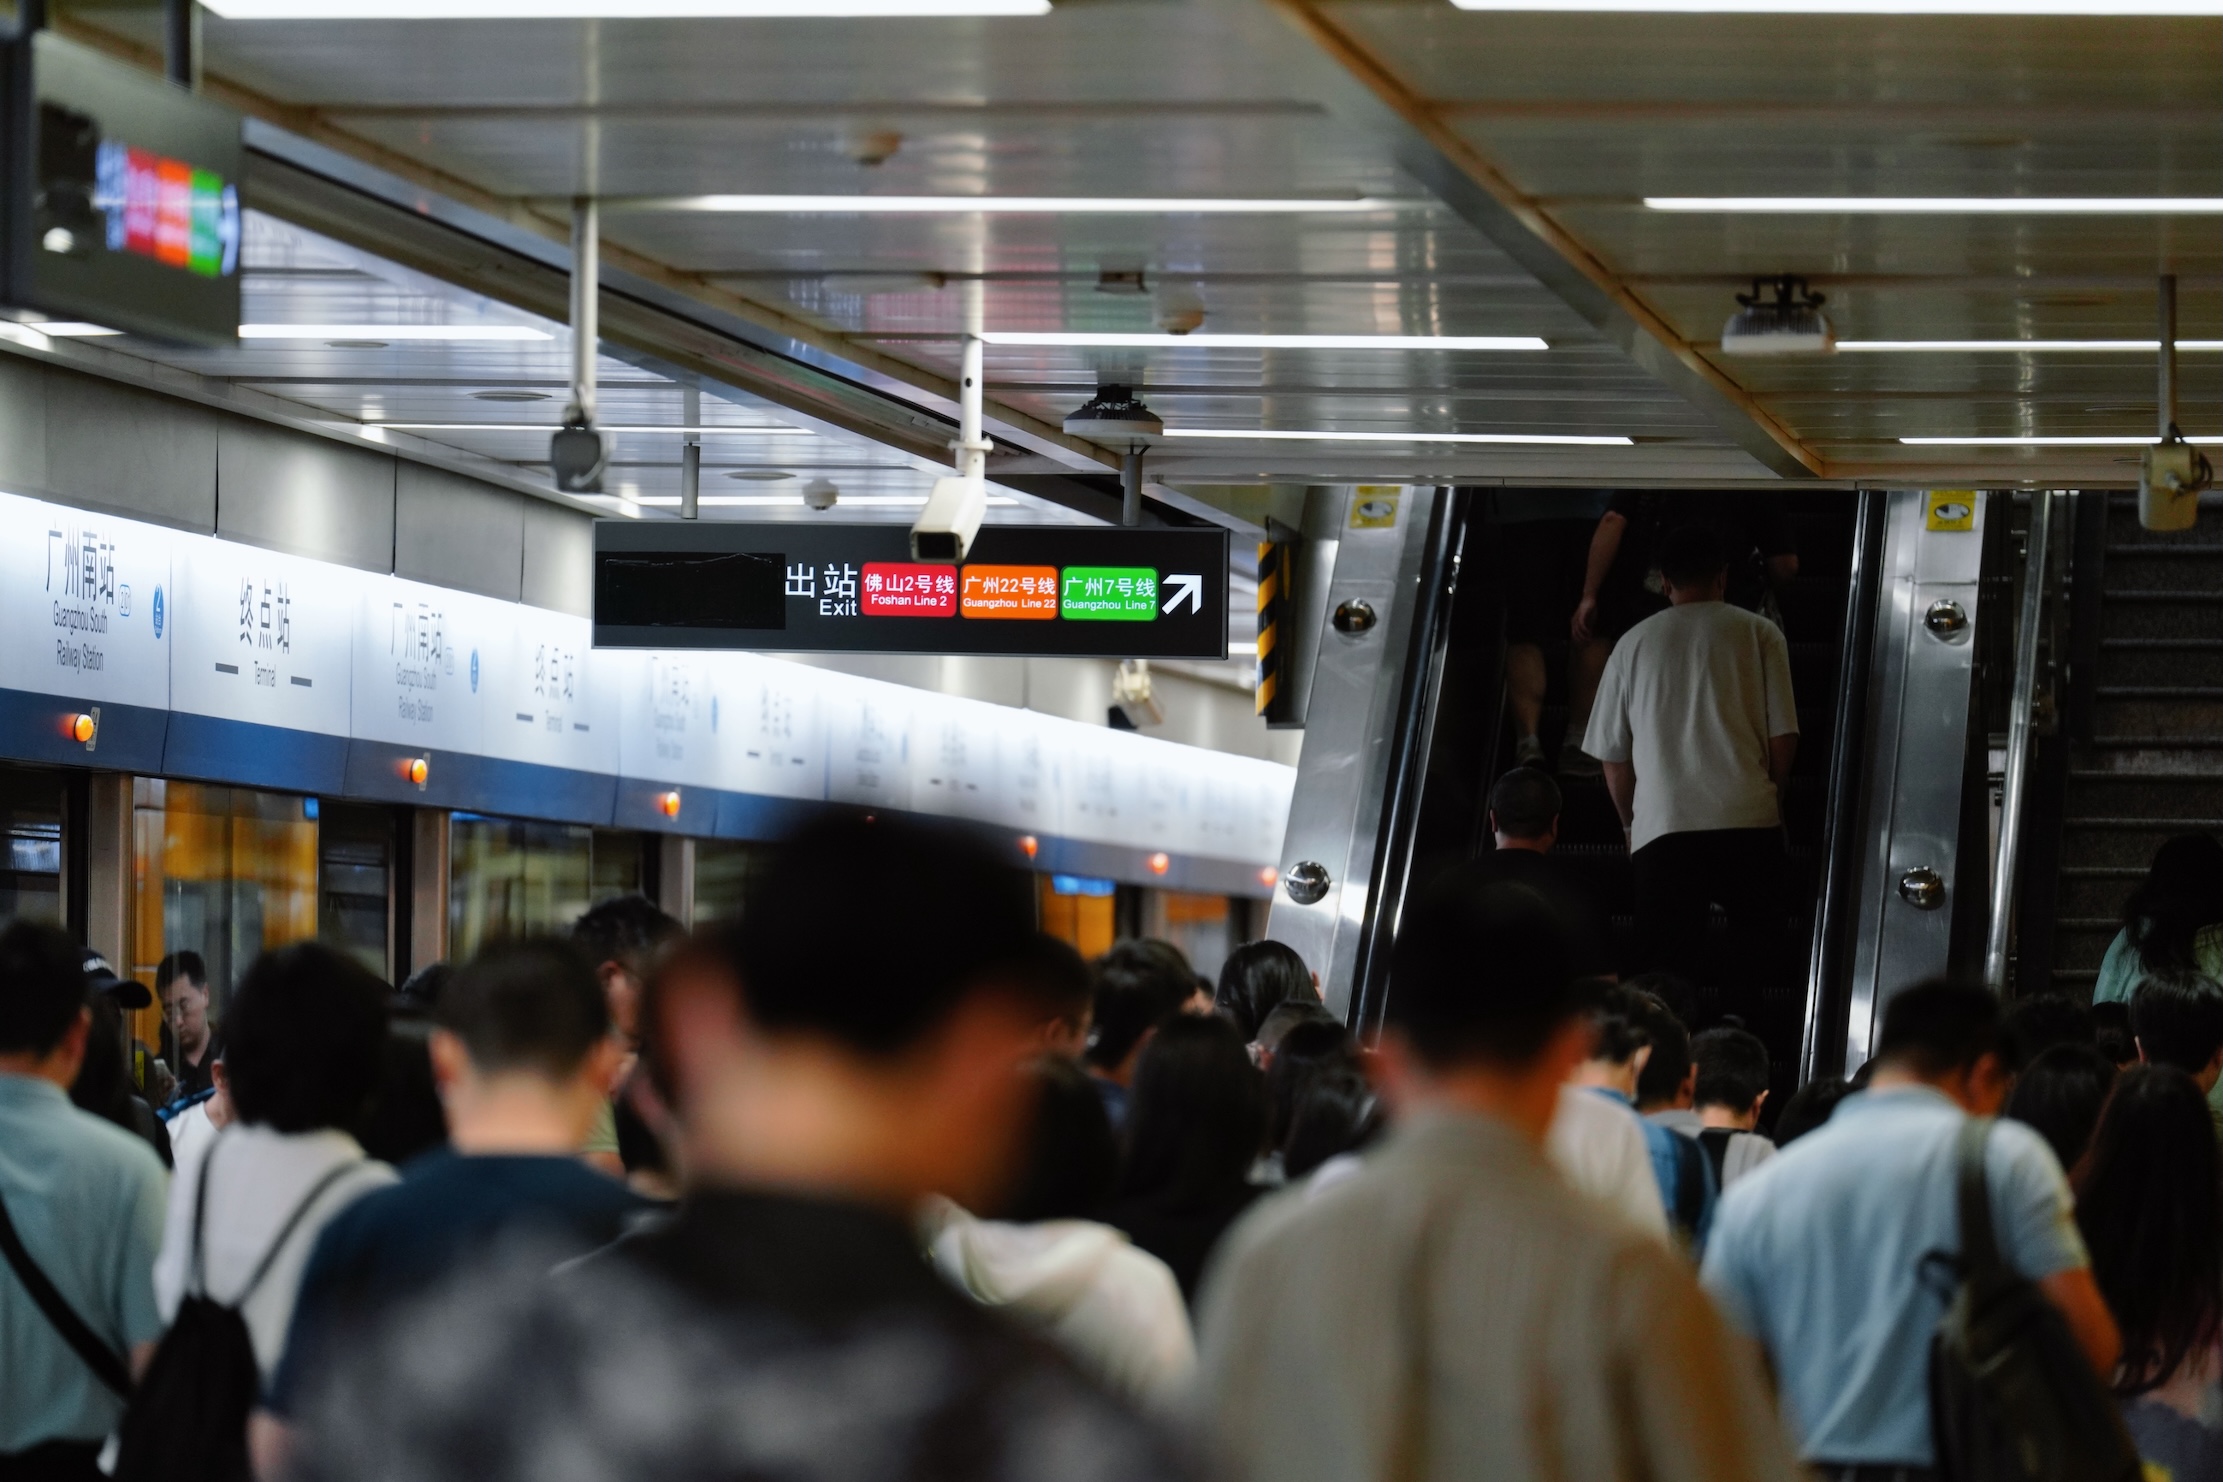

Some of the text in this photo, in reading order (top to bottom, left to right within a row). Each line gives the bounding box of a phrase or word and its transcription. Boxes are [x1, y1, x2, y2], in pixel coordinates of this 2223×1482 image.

[46, 518, 115, 605] 广州南站
[785, 563, 858, 598] 出站
[865, 573, 955, 594] 佛山2号线
[963, 576, 1056, 595] 广州22号线
[1063, 577, 1155, 597] 广州7号线
[820, 599, 857, 616] Exit
[871, 594, 947, 606] Foshan Line 2
[963, 598, 1055, 609] Guangzhou Line 22
[1063, 600, 1155, 611] Guangzhou Line 7
[54, 600, 107, 635] Guangzhou South
[239, 575, 291, 654] 终点站
[57, 639, 103, 674] Railway Station
